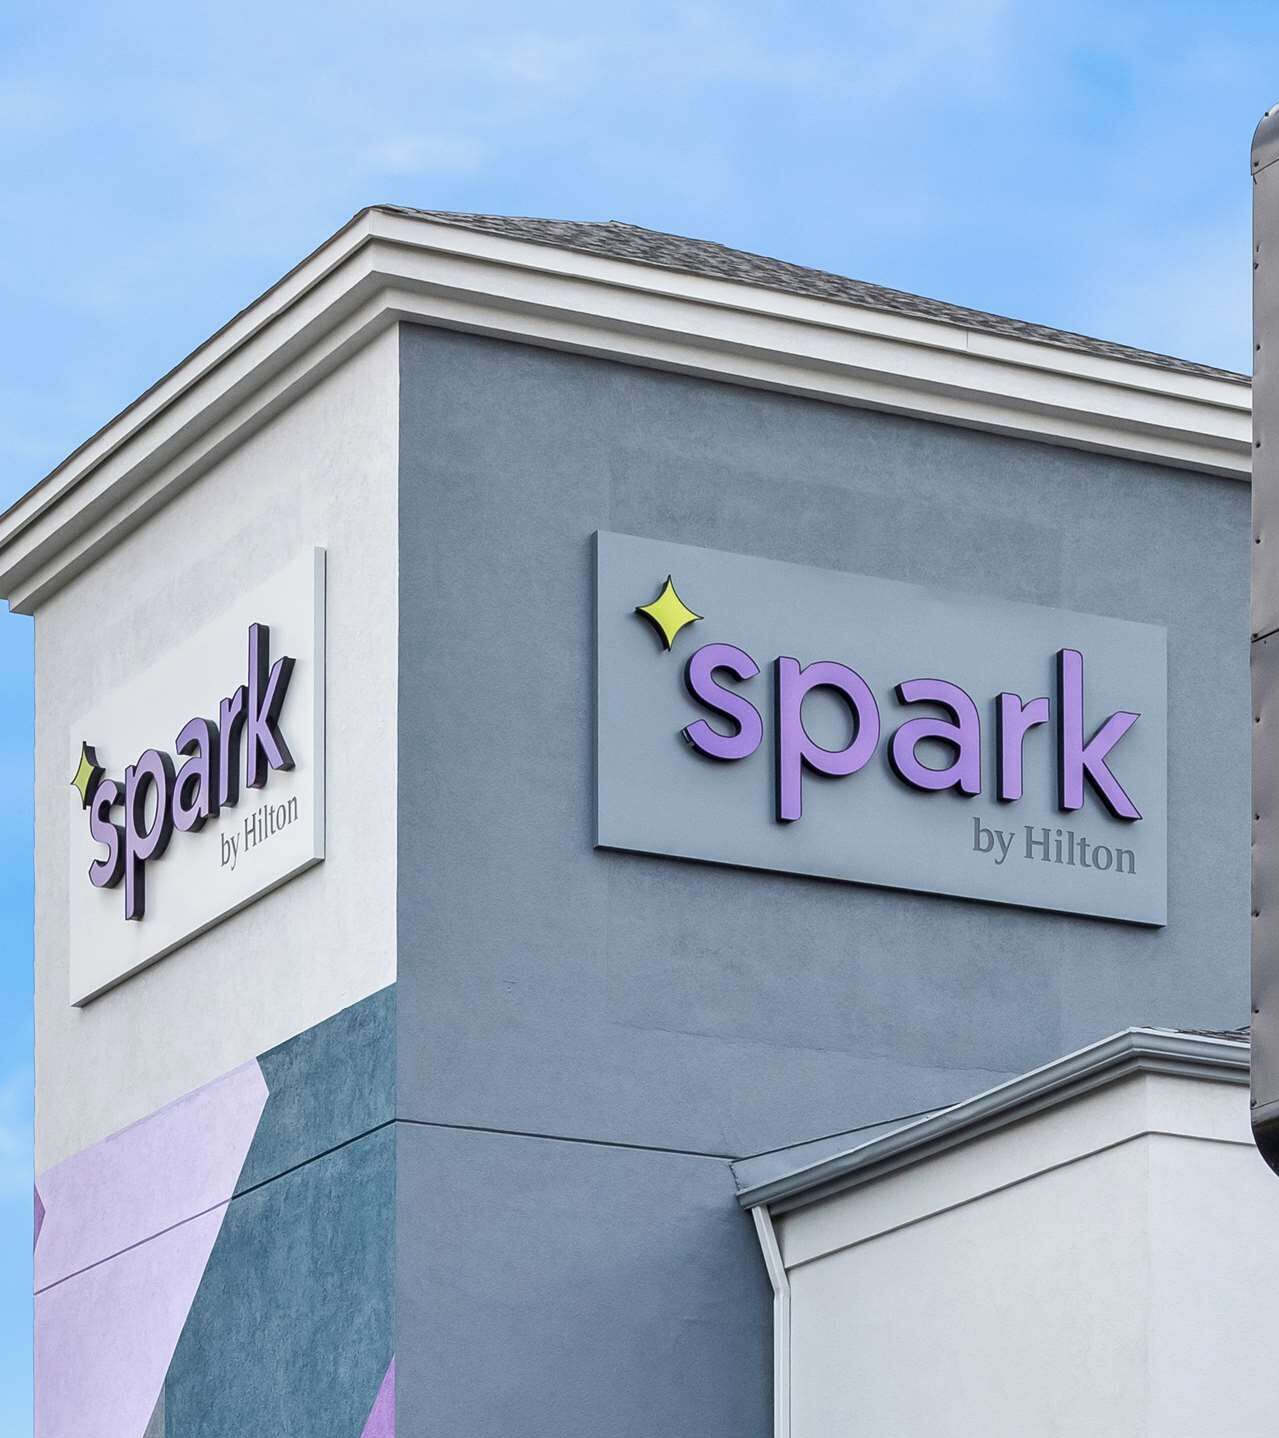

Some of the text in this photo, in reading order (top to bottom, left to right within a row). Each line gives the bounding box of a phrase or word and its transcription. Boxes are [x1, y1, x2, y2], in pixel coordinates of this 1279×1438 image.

[88, 622, 296, 921] spark
[680, 642, 1143, 823] spark
[221, 796, 298, 871] by Hilton
[972, 817, 1137, 874] by Hilton
